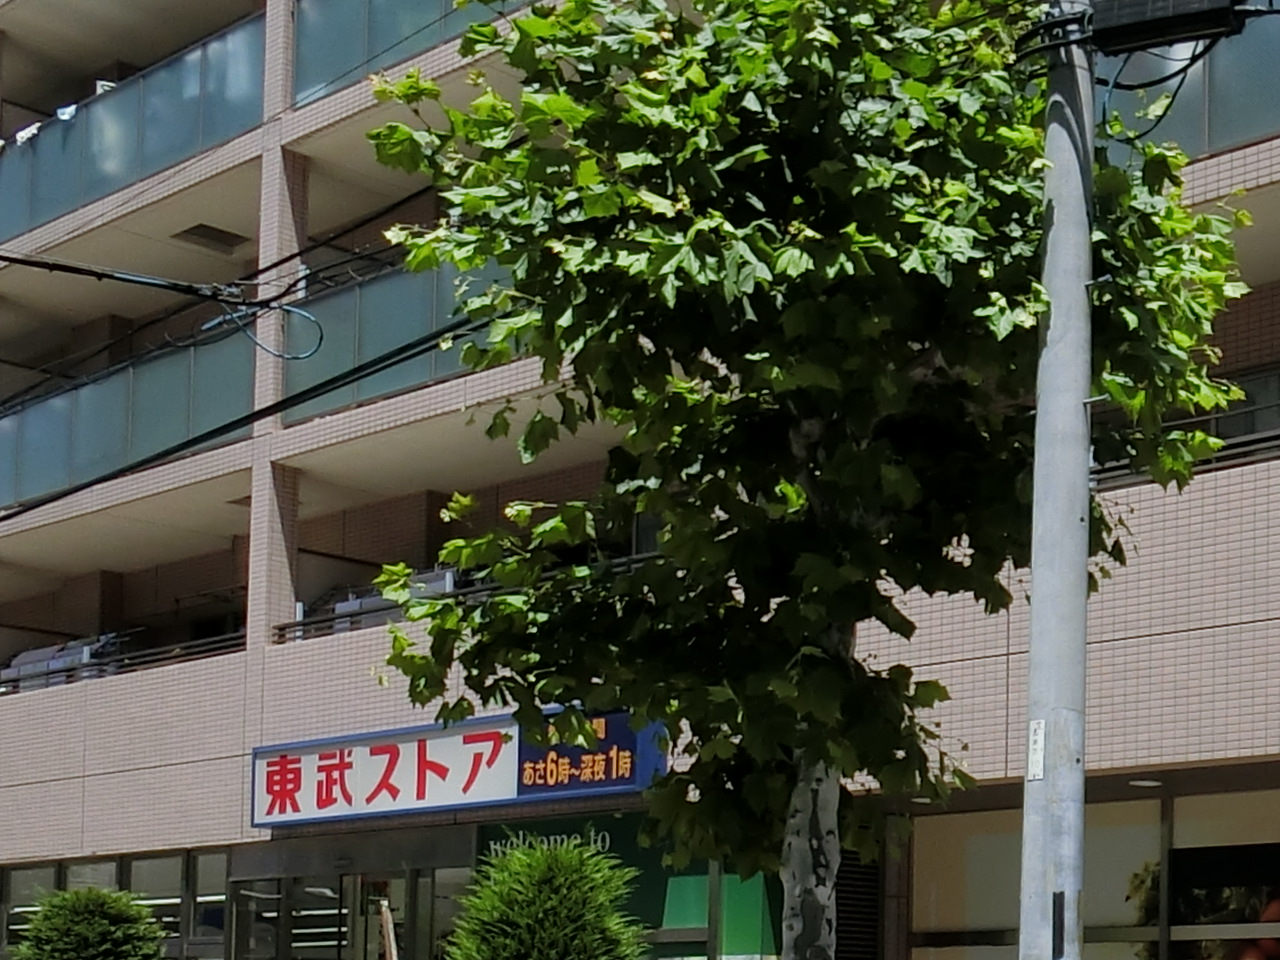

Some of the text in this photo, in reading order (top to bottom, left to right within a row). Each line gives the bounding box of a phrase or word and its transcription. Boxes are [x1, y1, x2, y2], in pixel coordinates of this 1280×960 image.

[265, 730, 505, 816] 東武ストア
